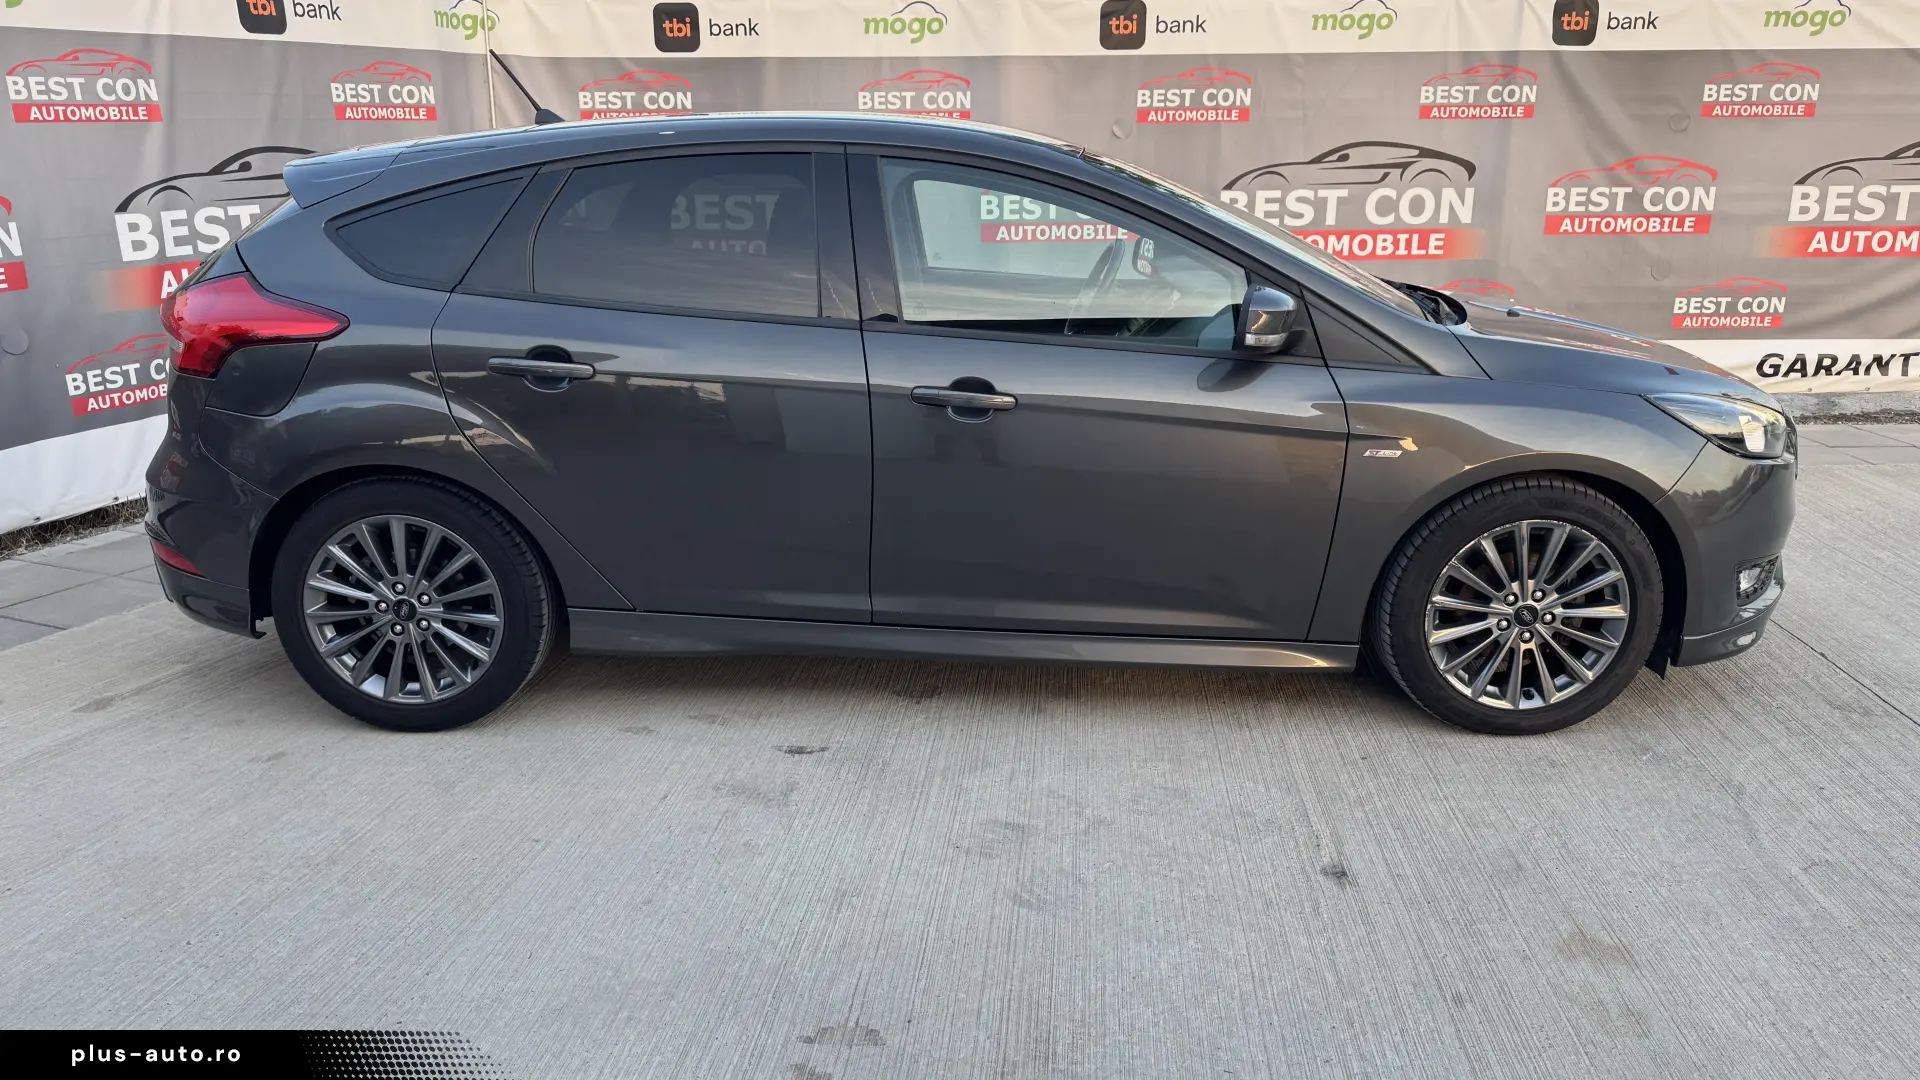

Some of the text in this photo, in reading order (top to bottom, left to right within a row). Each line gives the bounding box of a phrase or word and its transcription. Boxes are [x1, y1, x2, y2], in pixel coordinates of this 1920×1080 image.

[246, 0, 342, 21] tbi bank
[1561, 10, 1658, 31] tbi bank
[1763, 4, 1847, 37] mogo
[433, 9, 497, 40] mogo
[662, 17, 760, 38] tbi bank
[863, 14, 945, 44] mogo
[1109, 14, 1207, 35] tbi bank
[1311, 9, 1394, 40] mogo
[6, 76, 159, 102] BEST CON
[331, 83, 436, 105] BEST CON
[1136, 87, 1252, 108] BEST CON
[1420, 84, 1537, 104] BEST CON
[1702, 82, 1820, 103] BEST CON
[578, 91, 692, 110] BEST CON
[858, 91, 971, 110] BEST CON
[1712, 104, 1806, 117] AUTOMOBILE
[29, 106, 149, 121] AUTOMOBILE
[345, 107, 428, 120] AUTOMOBILE
[1147, 109, 1240, 122] AUTOMOBILE
[1430, 106, 1525, 118] AUTOMOBILE
[1365, 187, 1475, 225] CON
[1545, 186, 1717, 213] BEST CON
[1788, 184, 1920, 222] BEST
[996, 224, 1128, 241] AUTOMOBILE
[1559, 217, 1695, 233] AUTOMOBILE
[1673, 296, 1787, 314] BEST CON
[1682, 317, 1772, 328] AUTOMOBILE
[65, 362, 140, 396] BEST
